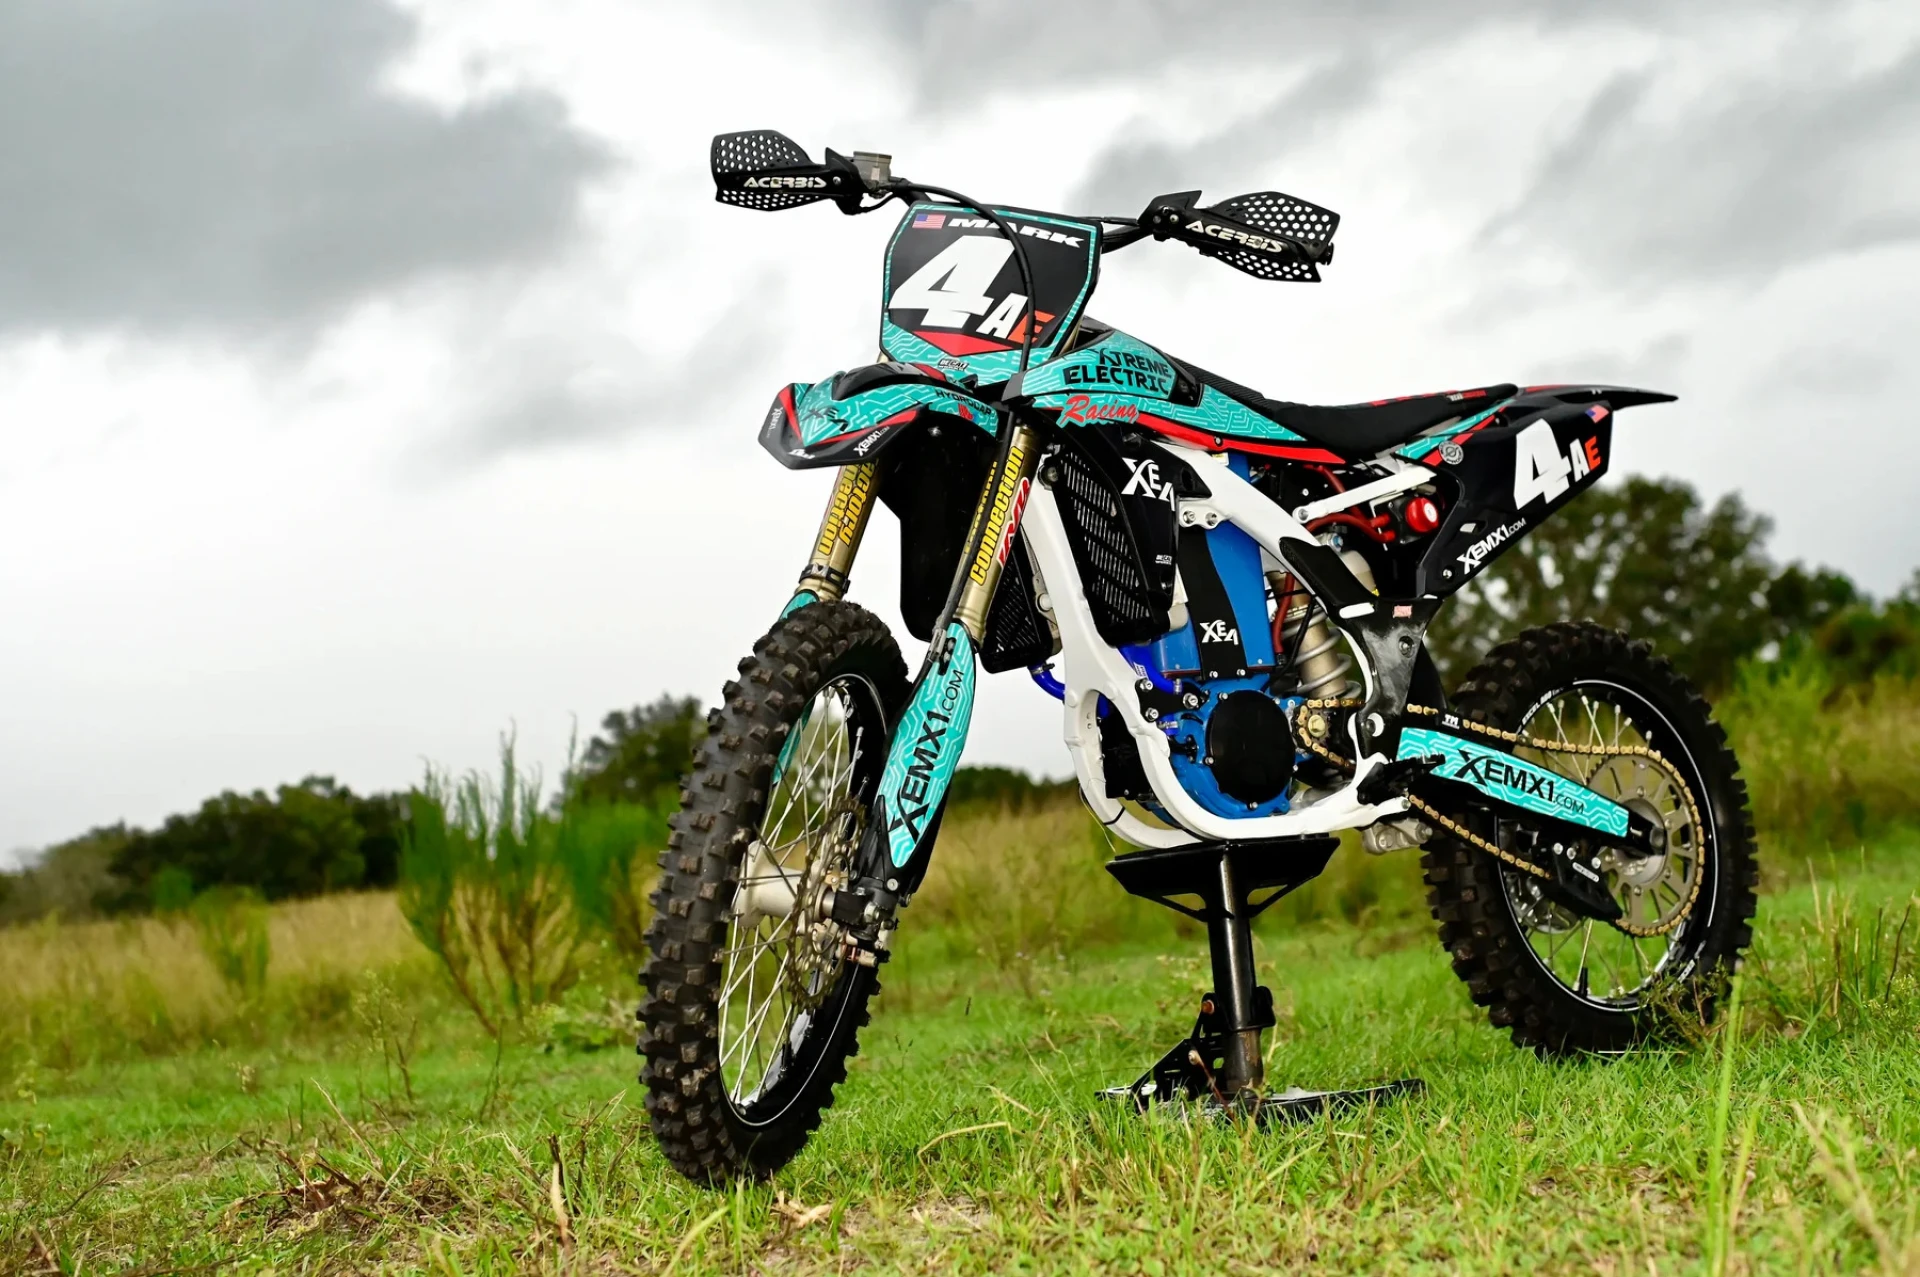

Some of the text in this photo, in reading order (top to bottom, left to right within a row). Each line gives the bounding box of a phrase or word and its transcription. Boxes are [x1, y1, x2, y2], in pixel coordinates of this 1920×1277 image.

[1060, 394, 1137, 424] Racing
[1063, 365, 1169, 396] ELECTRIC
[839, 461, 876, 547] actory
[1456, 518, 1526, 574] XEMX1.COM
[888, 669, 964, 844] XEMX1.COM
[1454, 749, 1585, 814] XEMX1.COM
